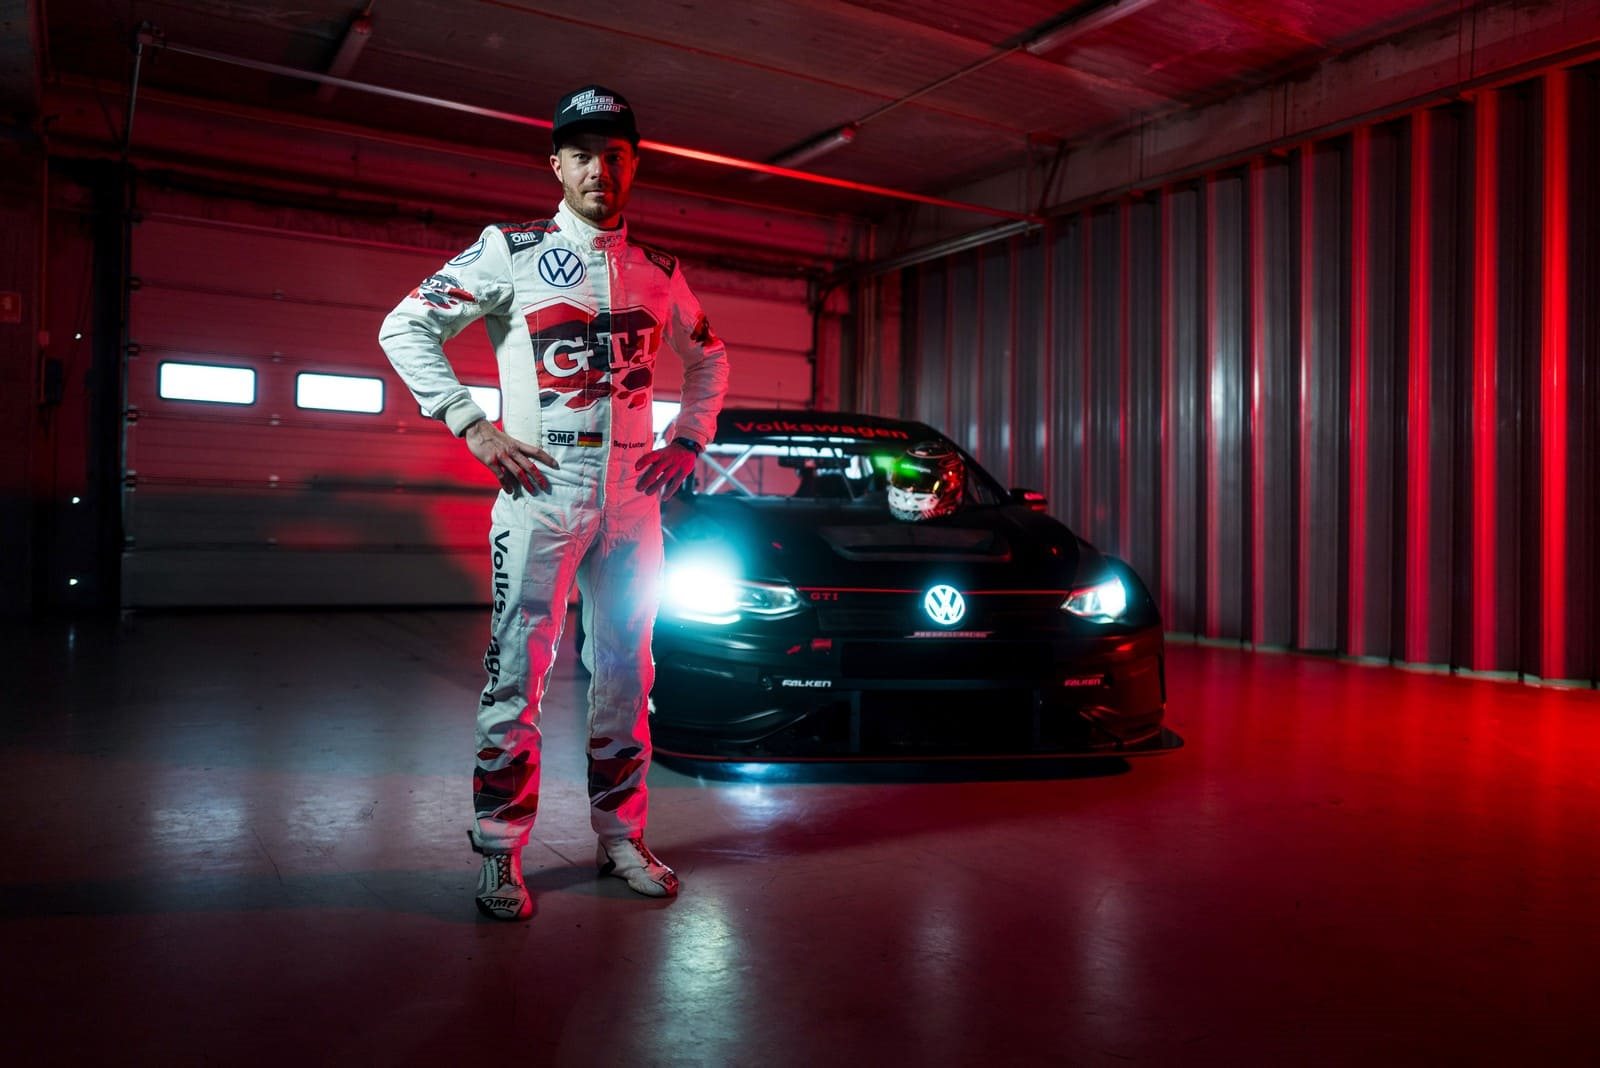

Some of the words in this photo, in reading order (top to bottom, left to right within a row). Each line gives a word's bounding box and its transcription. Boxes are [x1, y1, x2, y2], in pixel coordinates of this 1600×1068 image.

[512, 232, 536, 242] OMP
[538, 248, 584, 287] VW
[543, 328, 654, 378] GTI
[548, 433, 574, 443] OMP
[734, 420, 910, 441] Volkswagen
[810, 592, 840, 601] GTI
[924, 584, 966, 625] VW
[481, 530, 510, 707] Volksagen
[781, 679, 832, 688] FALKEN
